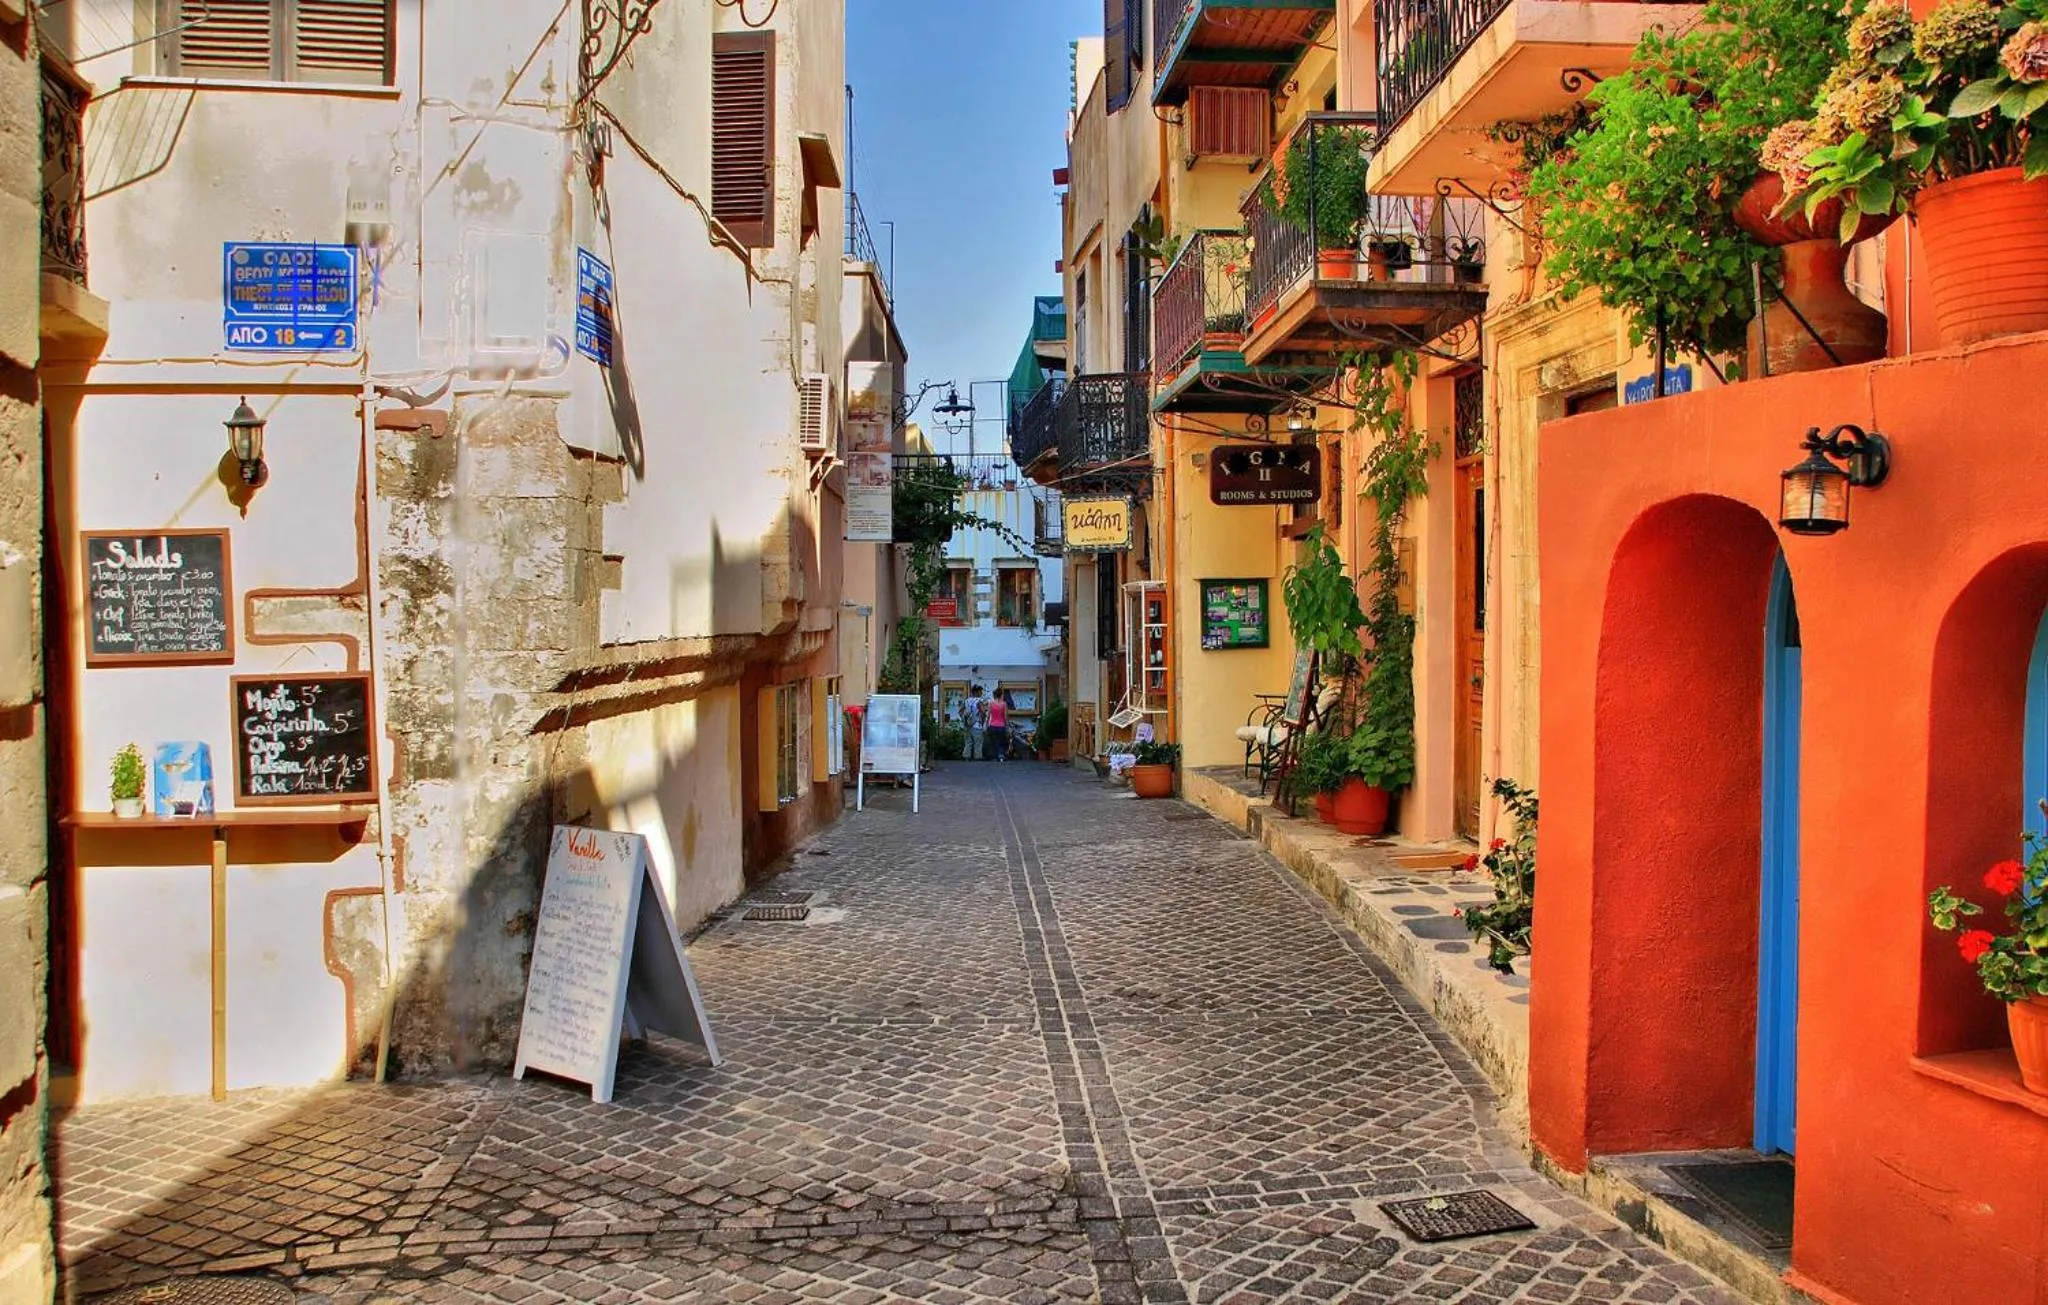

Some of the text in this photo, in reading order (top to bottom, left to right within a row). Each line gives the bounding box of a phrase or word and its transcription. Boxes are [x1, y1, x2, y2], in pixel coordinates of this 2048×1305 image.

[231, 327, 346, 346] ΑΠΟ 18 2
[1257, 468, 1272, 482] II
[1220, 489, 1314, 501] ROOMS & STUDIOS
[105, 537, 184, 569] Salads
